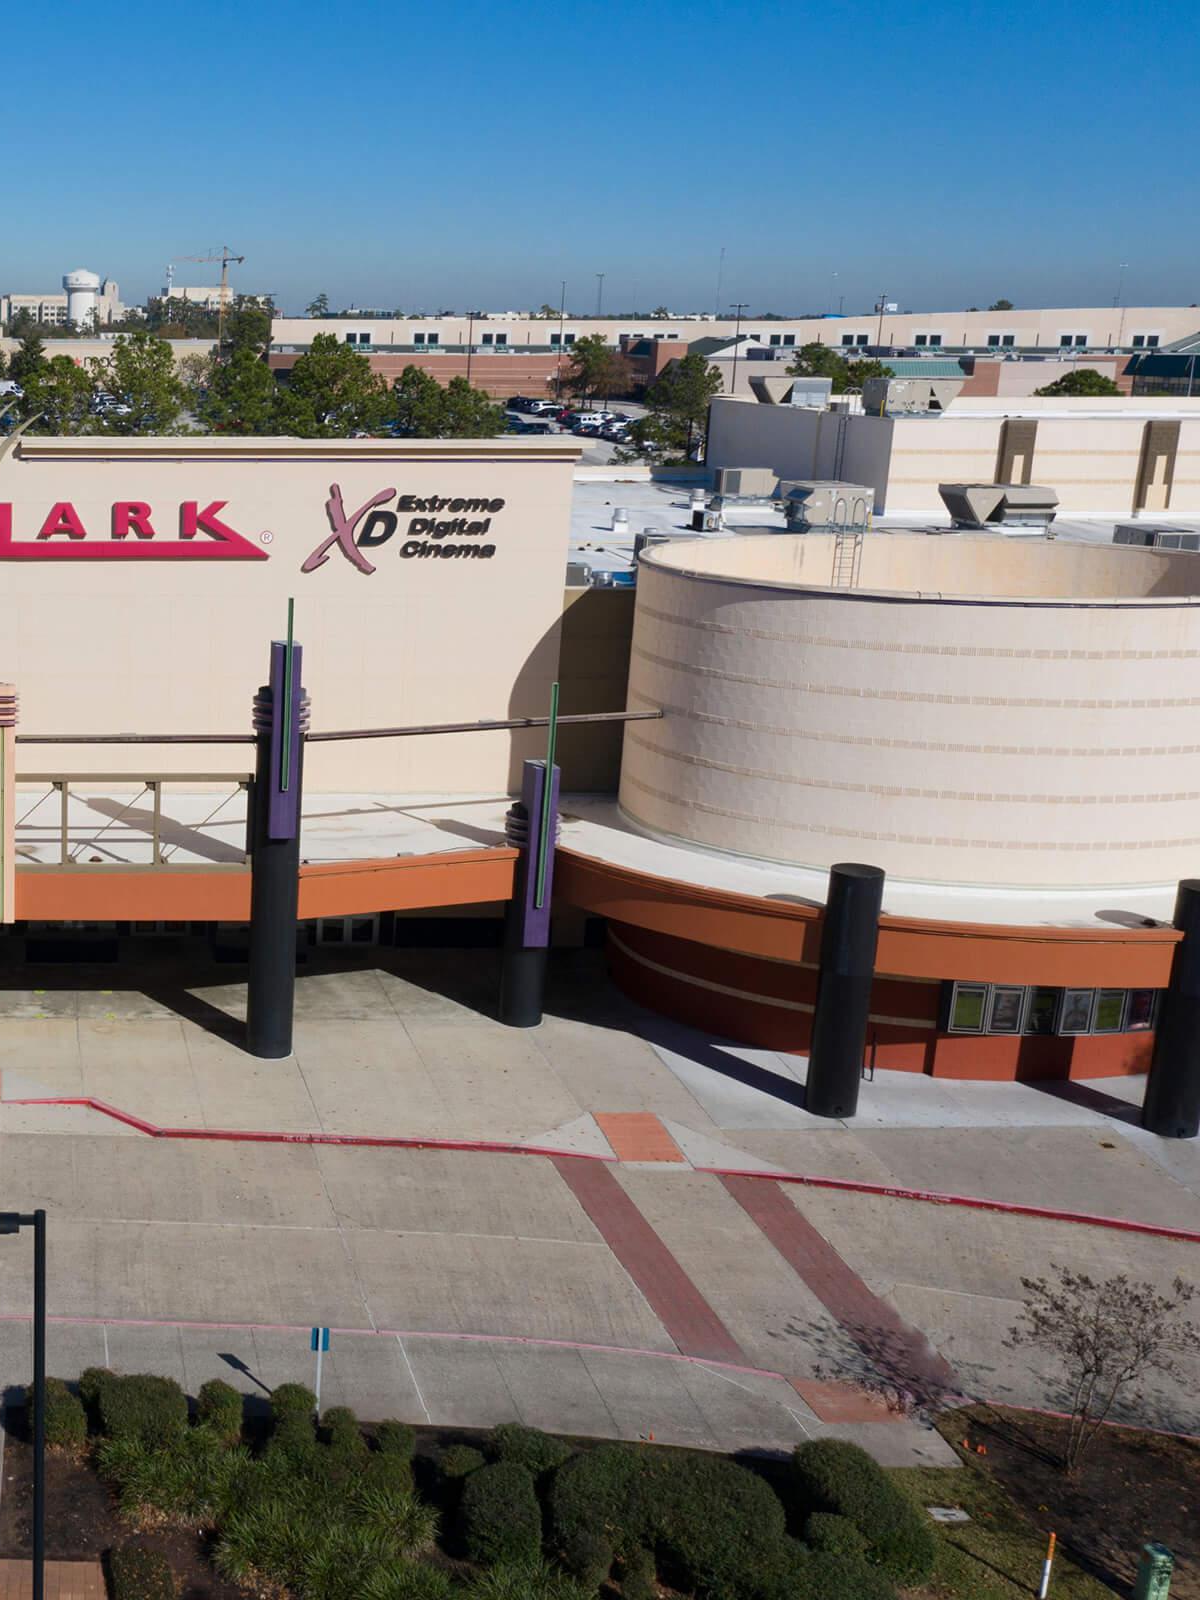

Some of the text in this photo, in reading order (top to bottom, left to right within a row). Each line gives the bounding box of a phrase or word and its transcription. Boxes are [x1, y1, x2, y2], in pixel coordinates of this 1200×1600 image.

[396, 495, 506, 513] Extreme
[300, 483, 398, 575] XD
[407, 518, 492, 539] Digital
[400, 540, 497, 559] Cinema
